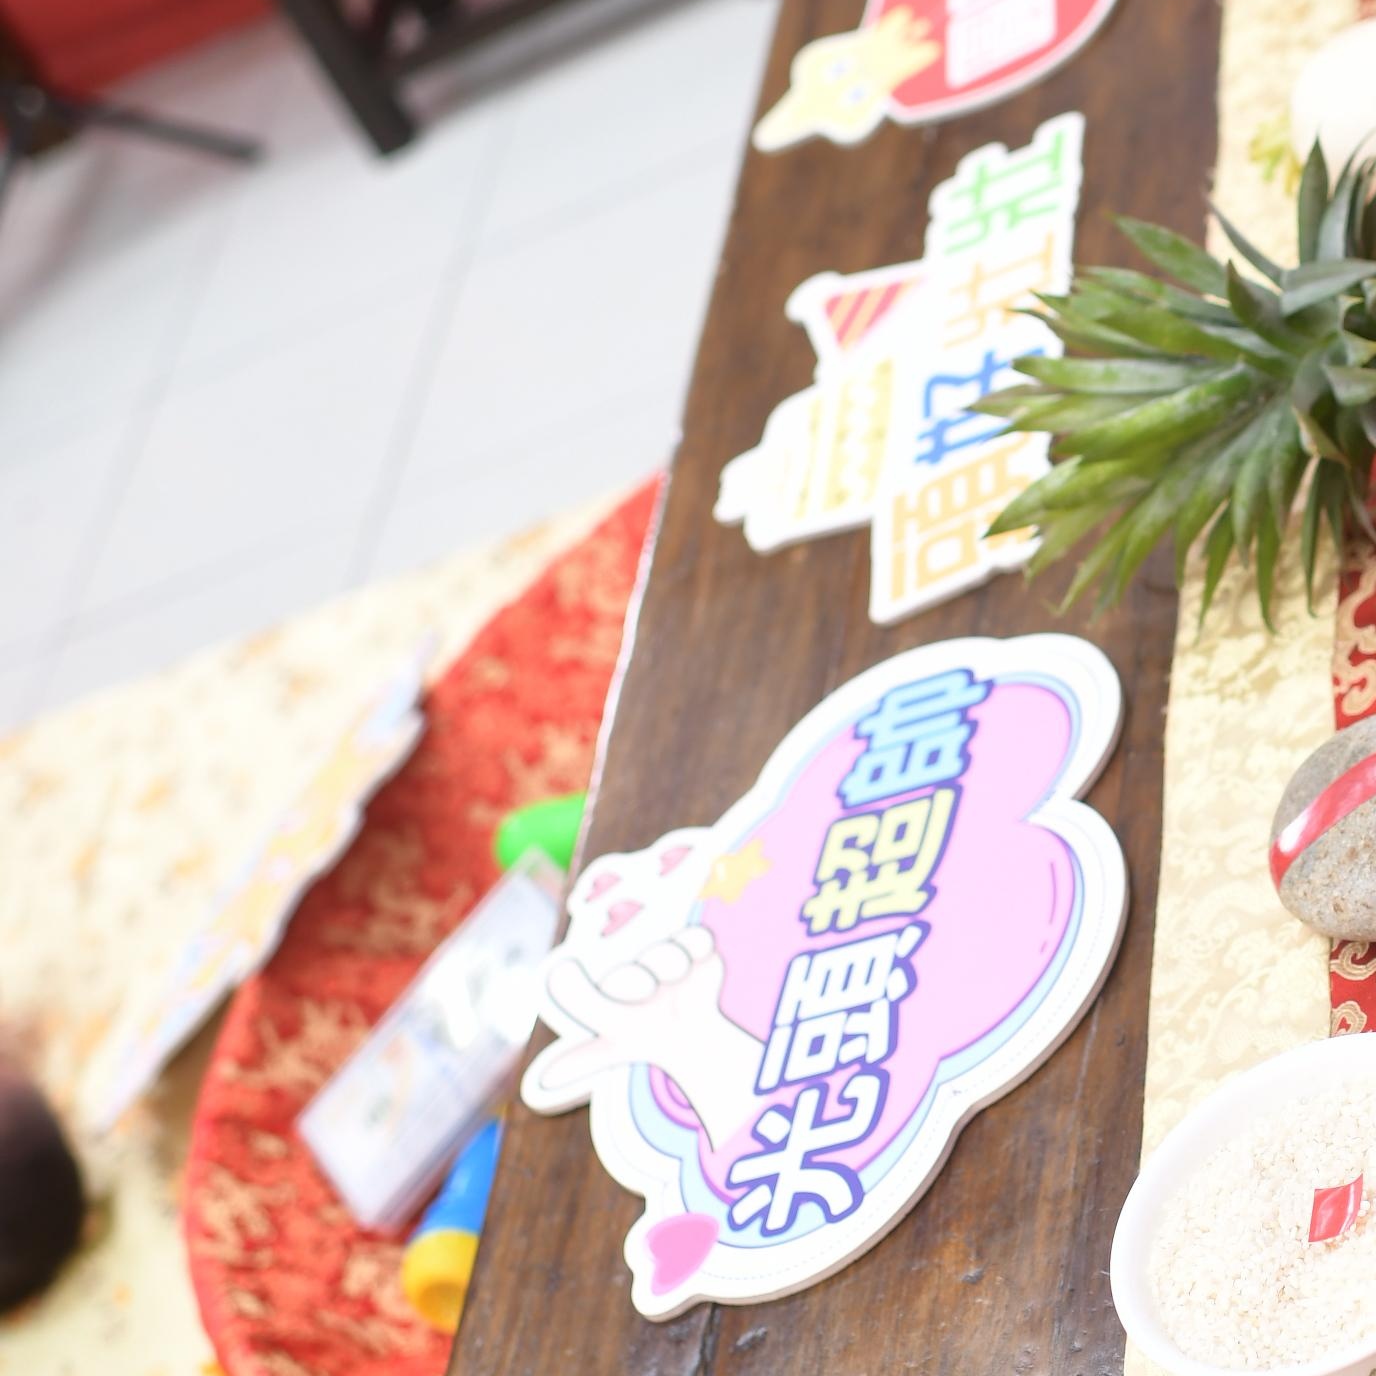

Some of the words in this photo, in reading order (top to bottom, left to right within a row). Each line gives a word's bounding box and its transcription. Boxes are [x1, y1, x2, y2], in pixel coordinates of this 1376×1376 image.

[891, 128, 1066, 601] 頭好壯壯
[726, 668, 993, 1234] 光頭超帥
